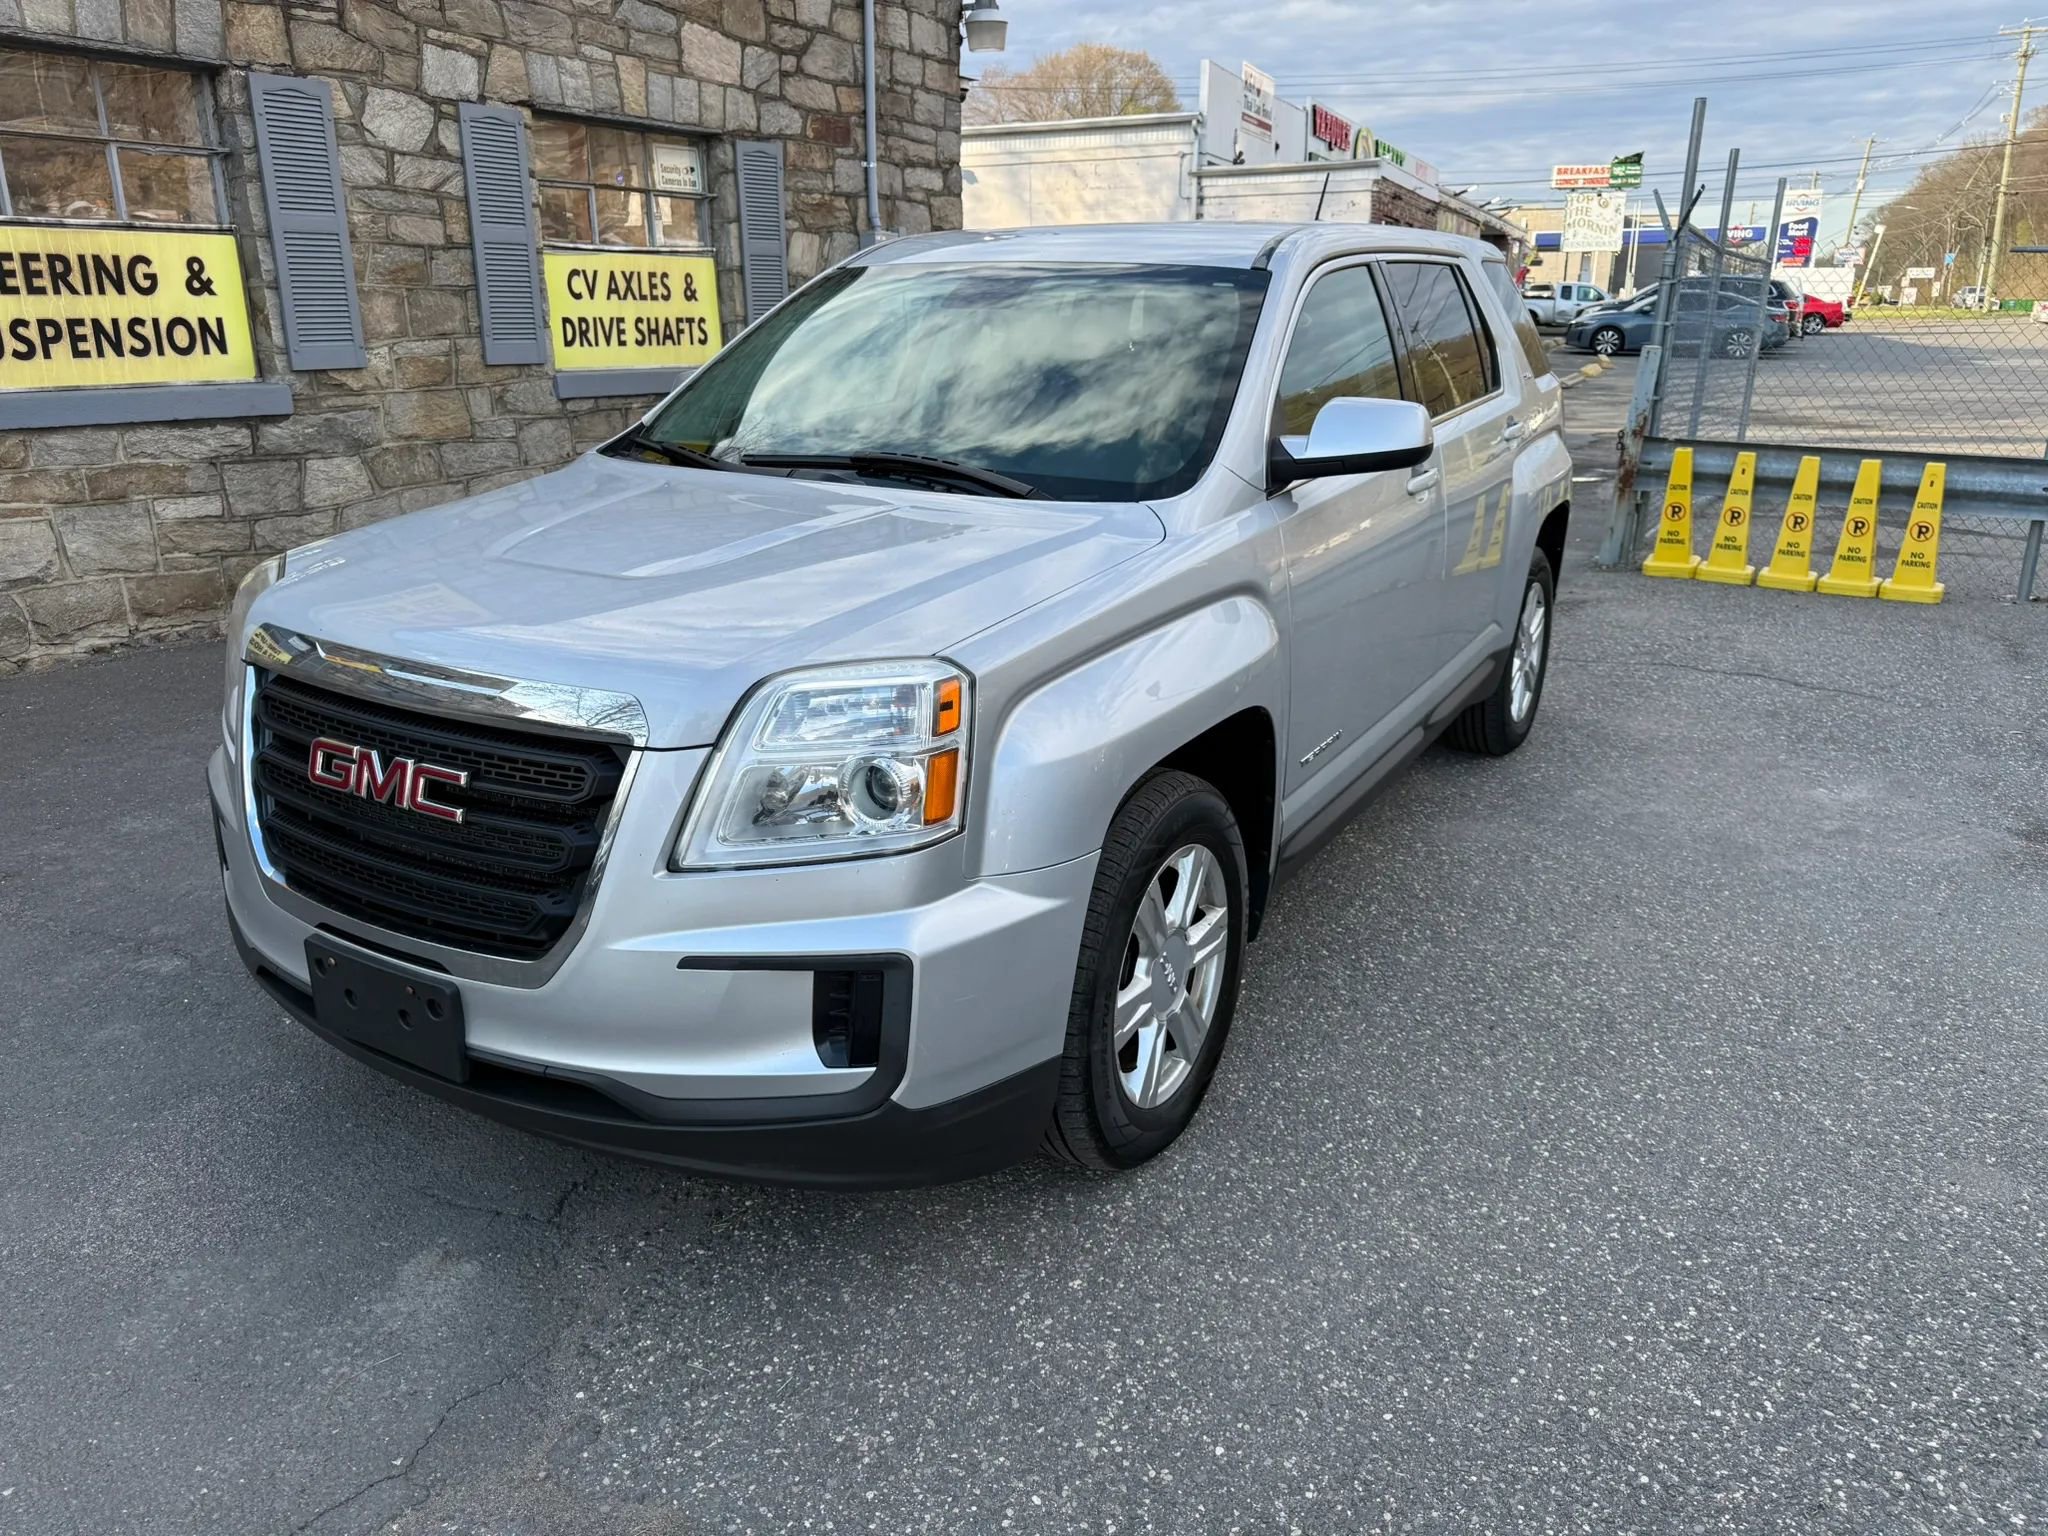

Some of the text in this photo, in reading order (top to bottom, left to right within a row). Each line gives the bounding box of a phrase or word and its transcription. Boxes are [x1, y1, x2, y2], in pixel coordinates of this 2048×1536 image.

[1557, 167, 1611, 176] BREAKFAST
[185, 256, 219, 296] &
[567, 269, 699, 302] CV AXLES &
[561, 316, 709, 348] DRIVE SHAFTS
[0, 316, 229, 361] SPENSION
[1793, 493, 1813, 501] CAUTION
[1853, 497, 1873, 505] CAUTION
[1917, 501, 1938, 509] CAUTION
[1715, 543, 1743, 552] PARKING
[1778, 549, 1806, 558] PARKING
[1910, 551, 1925, 559] NO
[1838, 554, 1867, 563] PARKING
[1901, 559, 1931, 569] PARKING
[308, 737, 468, 824] GMC
